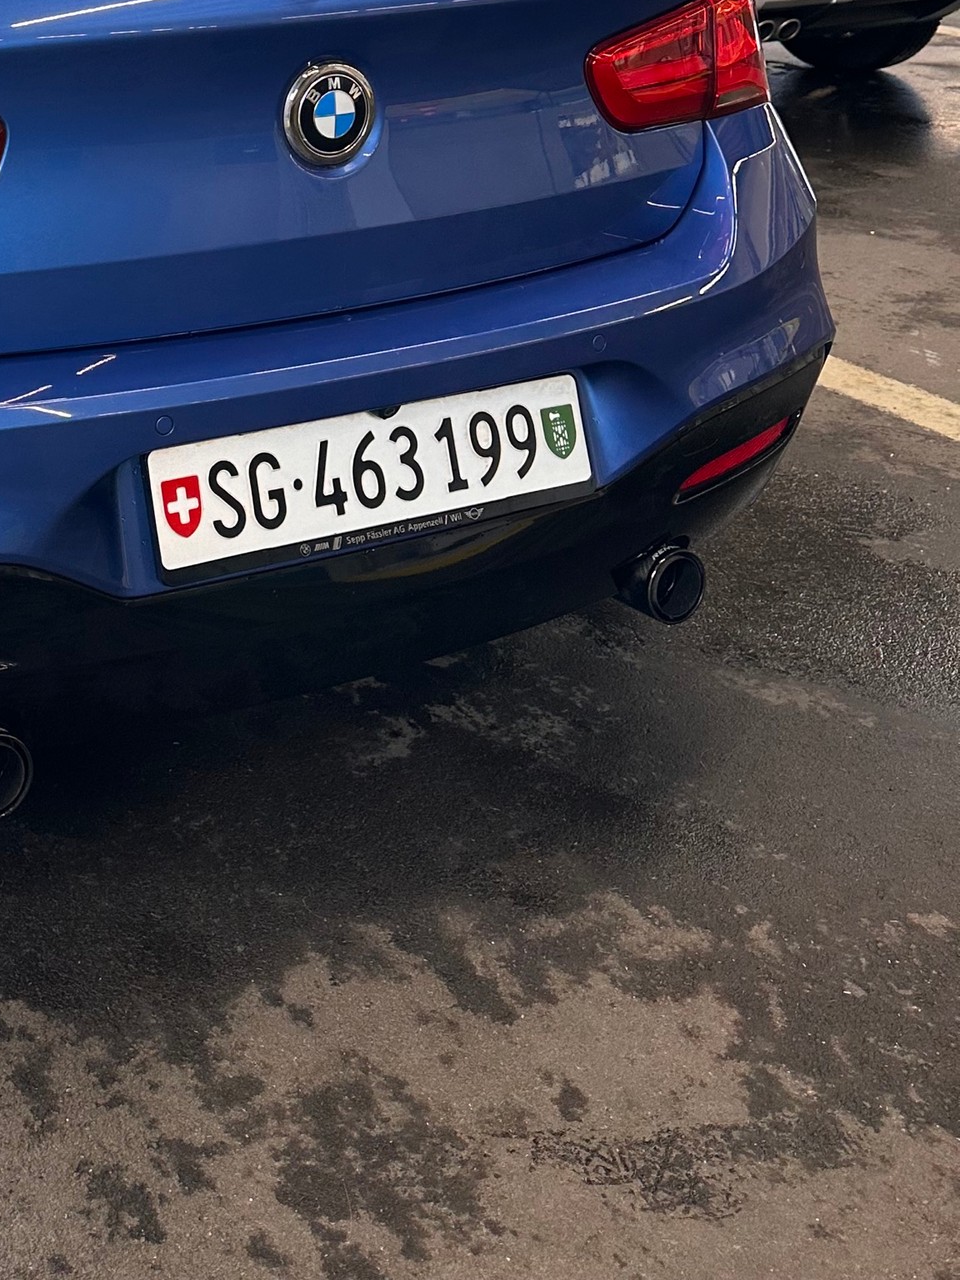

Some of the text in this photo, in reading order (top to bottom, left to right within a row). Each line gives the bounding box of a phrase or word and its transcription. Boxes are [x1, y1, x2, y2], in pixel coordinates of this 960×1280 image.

[306, 76, 362, 104] BMW
[346, 534, 366, 545] Sepp
[366, 528, 392, 540] Fässler
[393, 524, 405, 534] AG
[408, 516, 443, 532] Appenzell
